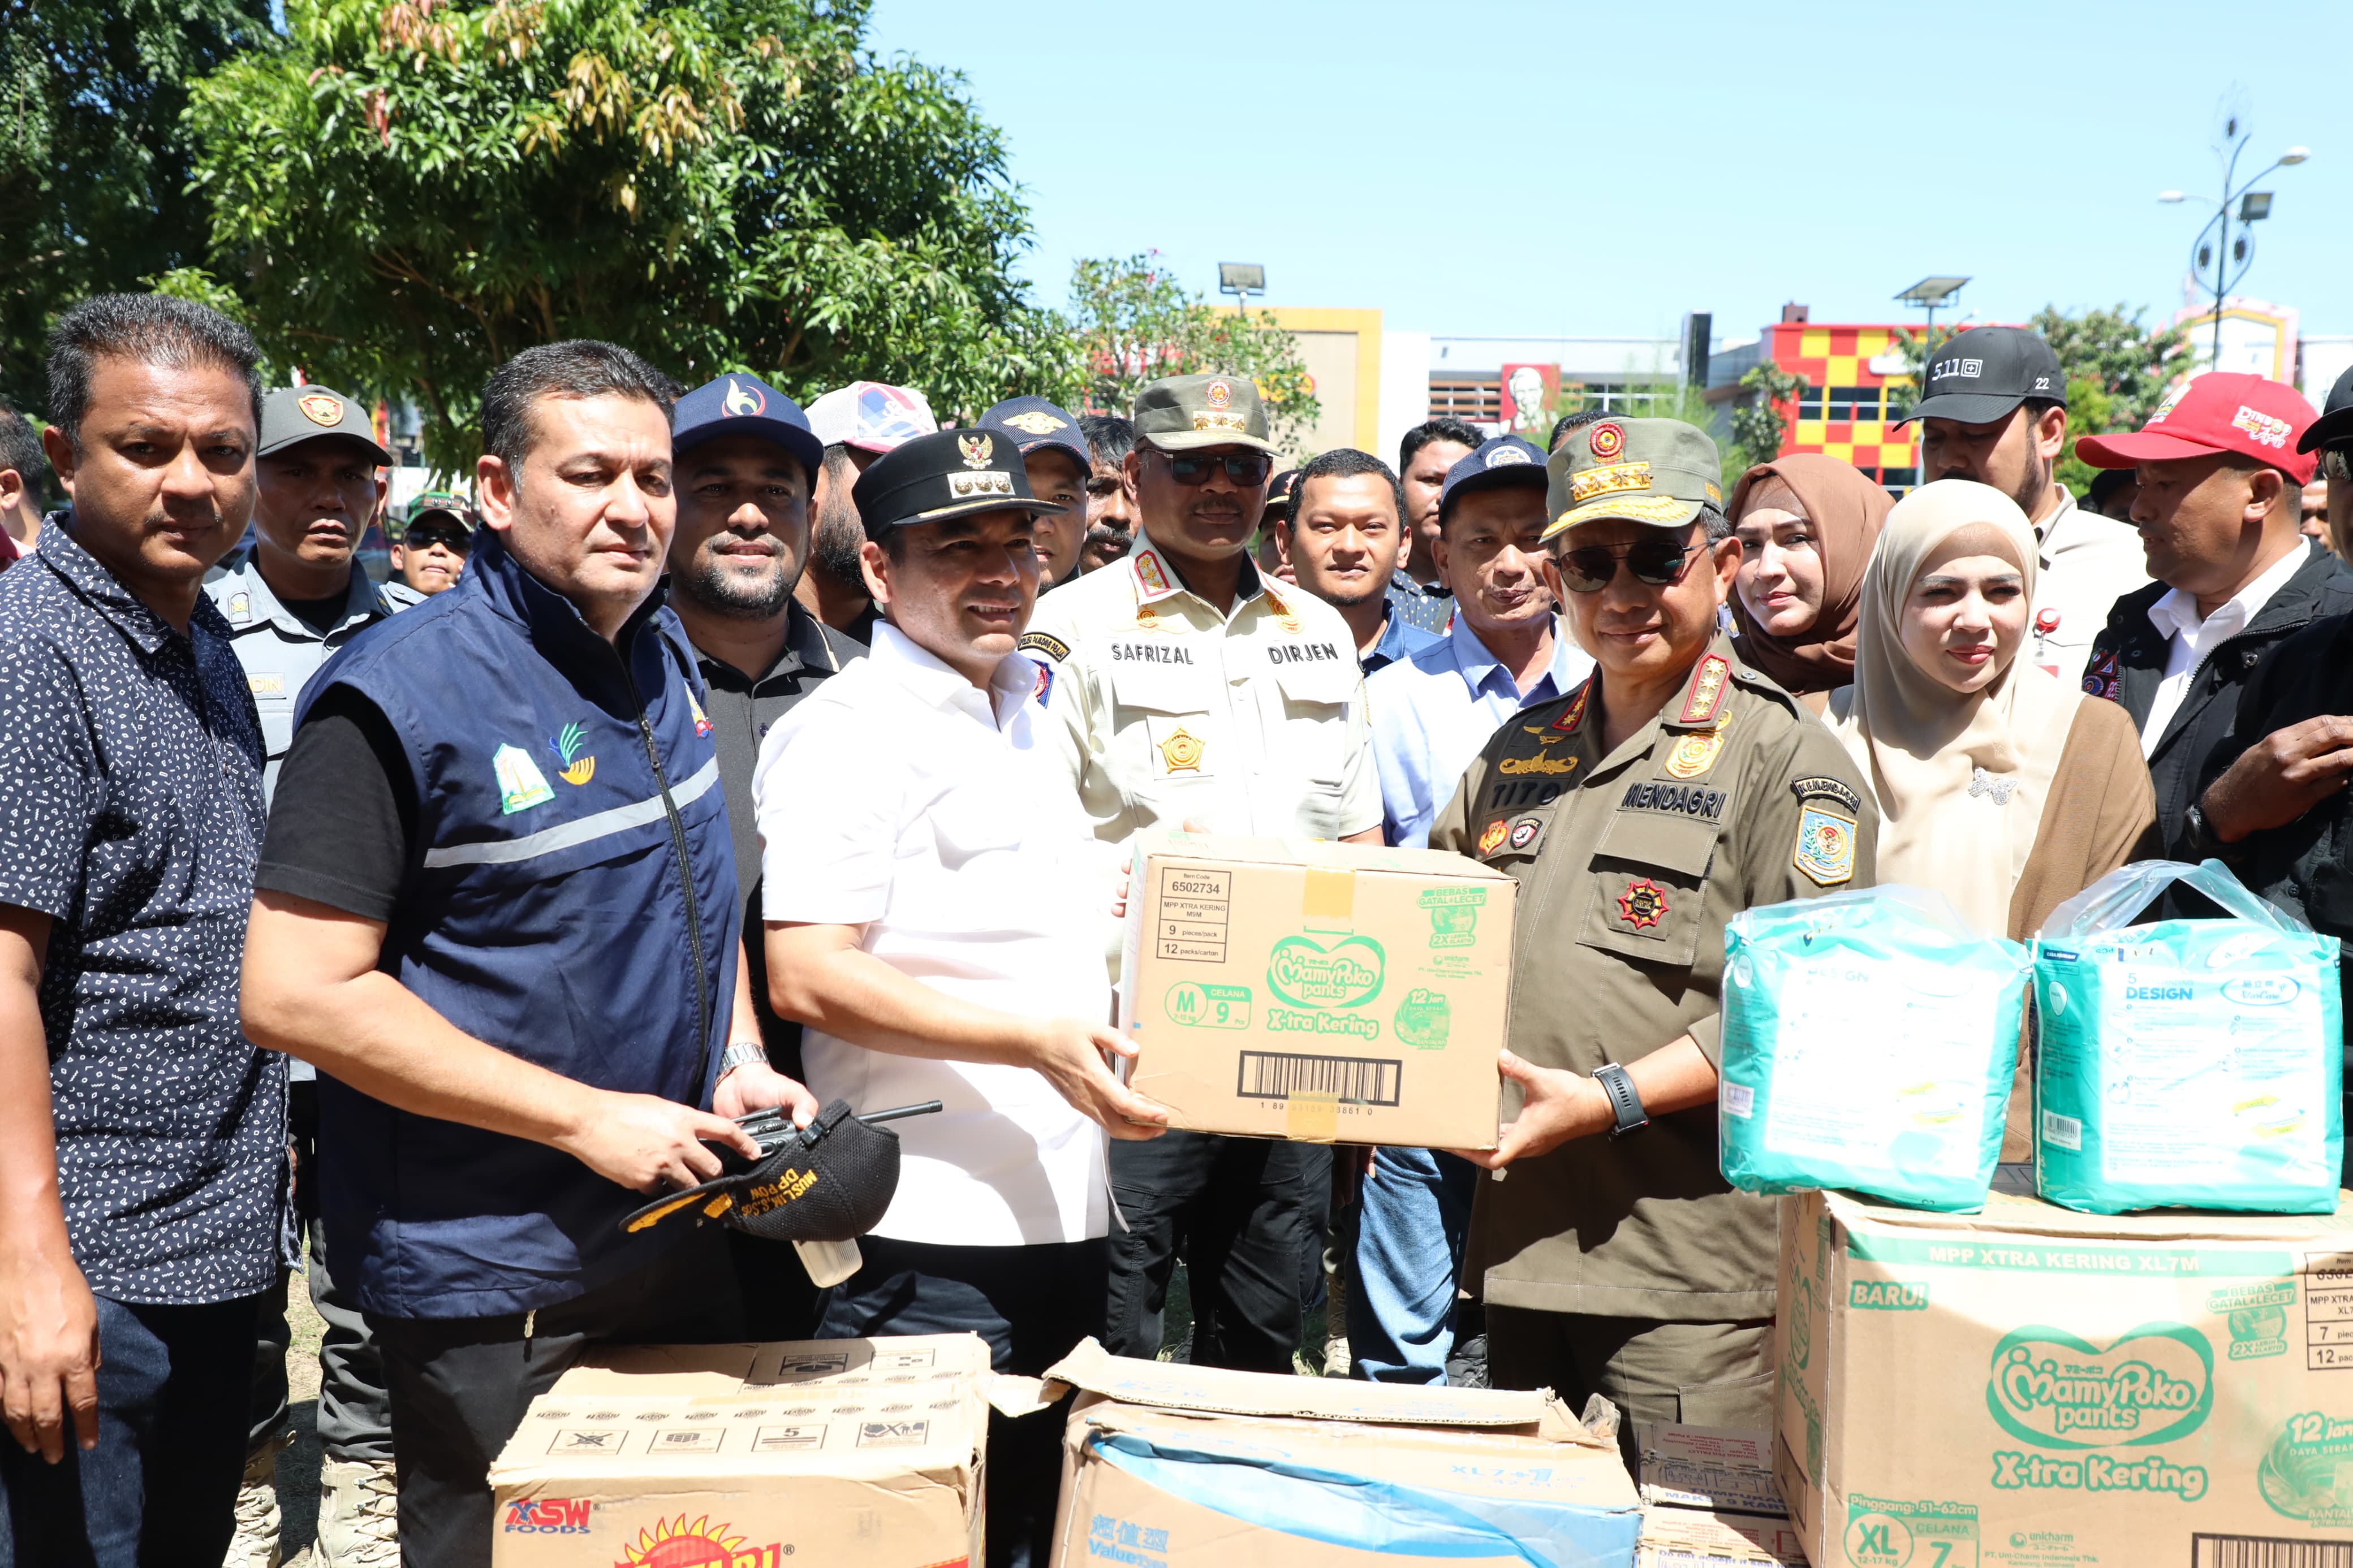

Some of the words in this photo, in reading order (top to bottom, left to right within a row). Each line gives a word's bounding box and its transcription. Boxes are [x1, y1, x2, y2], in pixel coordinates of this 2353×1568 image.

[2035, 377, 2050, 390] 22
[1111, 643, 1193, 664] SAFRIZAL
[1267, 643, 1338, 664] DIRJEN
[249, 676, 282, 693] DIN
[1492, 781, 1560, 809] TITO
[1622, 782, 1727, 818] MENDAGRI
[1798, 778, 1858, 807] KEMENDAGRI
[1172, 882, 1220, 894] 6502734
[1436, 887, 1468, 896] BEBAS
[1169, 925, 1176, 935] 9
[1165, 943, 1178, 954] 12
[1180, 948, 1218, 956] packs/carton
[1275, 950, 1376, 988] MamyPoko
[2128, 973, 2136, 984] 5
[1210, 988, 1246, 998] CELANA
[1302, 983, 1347, 999] pants
[1411, 989, 1427, 1004] 12
[2126, 987, 2193, 1000] DESIGN
[1176, 990, 1195, 1013] M
[1217, 1002, 1230, 1023] 9
[1267, 1008, 1315, 1031] X-tra
[1316, 1011, 1380, 1041] Kering
[1929, 1246, 1975, 1263] MPP
[1981, 1249, 2040, 1267] XTRA
[2046, 1252, 2131, 1270] KERING
[2139, 1255, 2200, 1271] XL7M
[1852, 1284, 1925, 1306] BARU!
[2230, 1284, 2273, 1297] BEBAS
[2209, 1297, 2250, 1310] GATAL
[2256, 1291, 2292, 1304] LECET
[2311, 1296, 2329, 1305] MPP
[2320, 1327, 2329, 1340] 7
[2234, 1342, 2253, 1356] 2X
[2316, 1349, 2335, 1364] 12
[2002, 1349, 2197, 1411] MamyPoko
[2055, 1404, 2140, 1434] pants
[783, 1428, 800, 1437] 5
[2291, 1414, 2322, 1443] 12
[2290, 1447, 2317, 1457] DAYA
[1991, 1450, 2083, 1489] X-tra
[2085, 1454, 2208, 1501] Kering
[1850, 1494, 1915, 1515] Pinggang:
[505, 1524, 591, 1534] FOODS
[1915, 1522, 1971, 1535] CELANA
[1856, 1522, 1899, 1556] XL
[2029, 1531, 2074, 1544] unicharm
[1699, 1554, 1736, 1565] accept
[1858, 1556, 1884, 1565] 12-17
[1885, 1557, 1899, 1567] kg
[1930, 1541, 1953, 1568] 7
